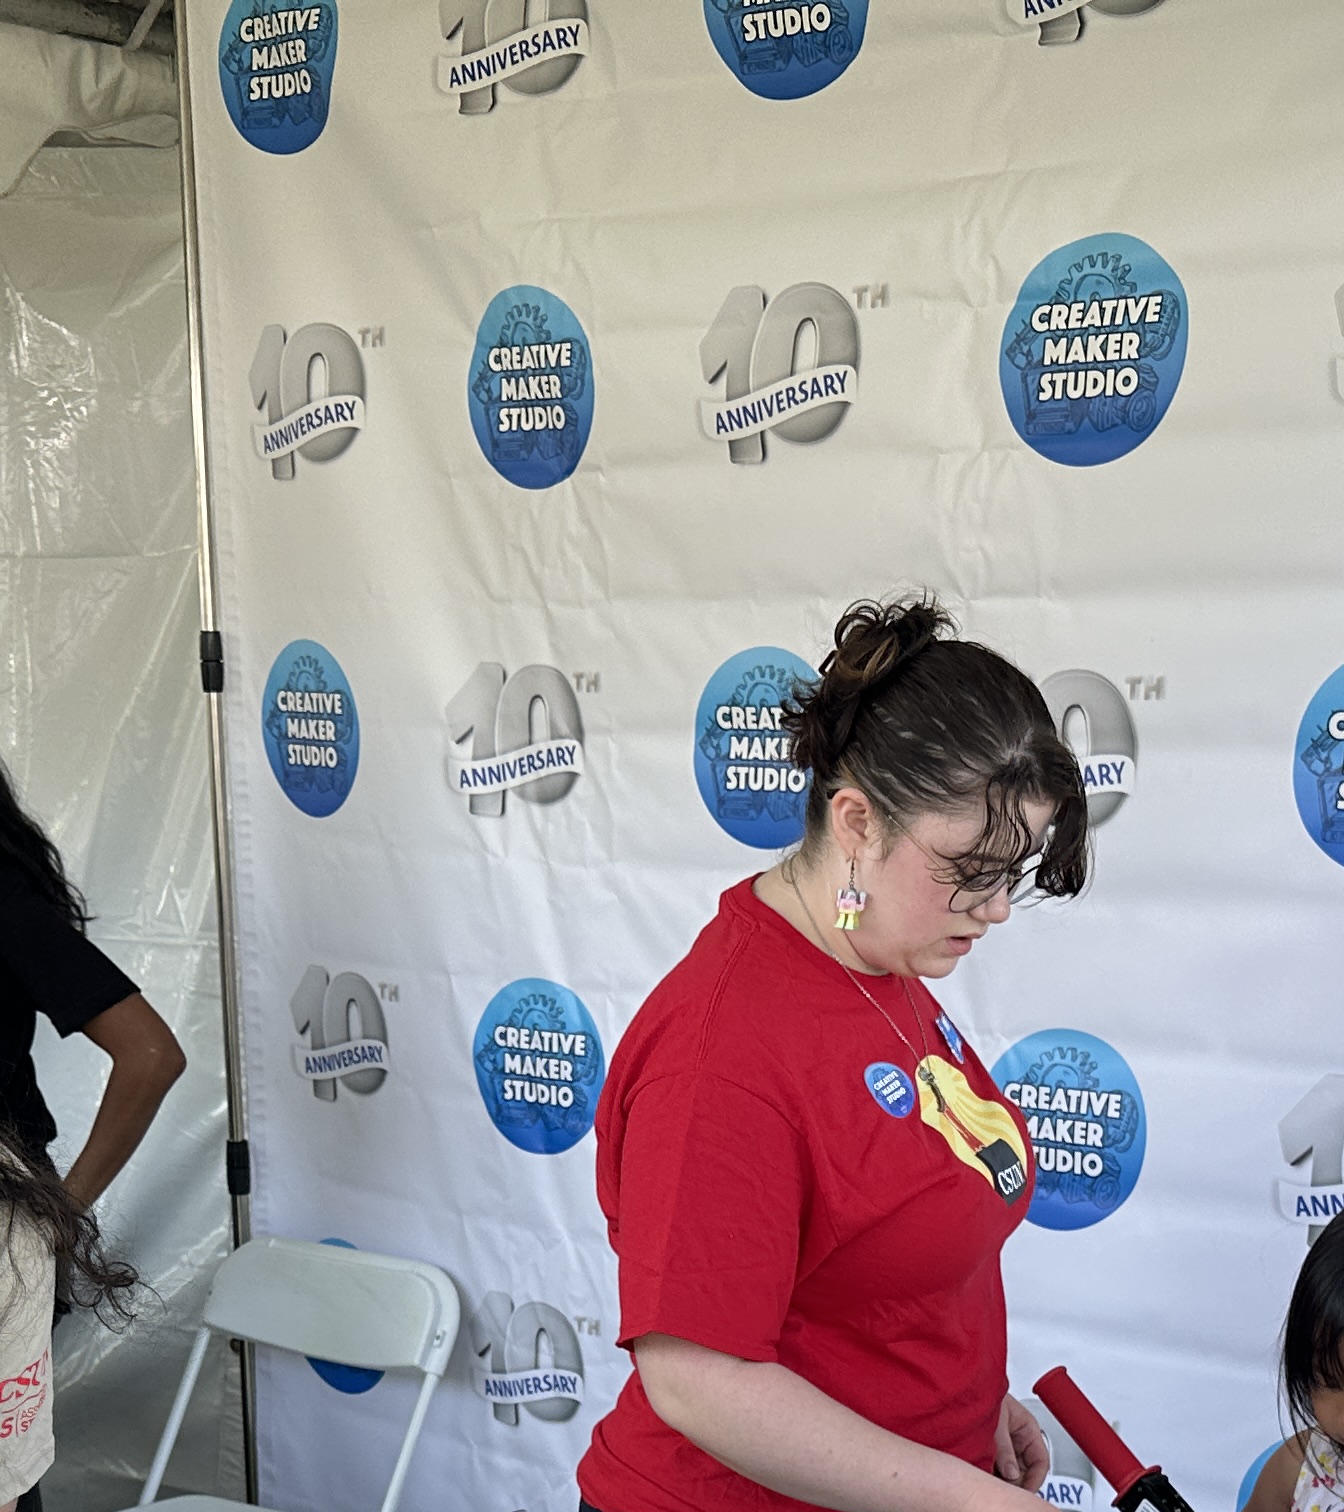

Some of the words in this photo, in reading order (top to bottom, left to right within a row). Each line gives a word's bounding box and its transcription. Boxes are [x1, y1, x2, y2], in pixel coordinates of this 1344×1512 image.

[239, 8, 320, 44] CREATIVE
[742, 3, 831, 42] STUDIO
[252, 38, 307, 72] MAKER
[449, 24, 581, 88] ANNIVERSARY
[250, 70, 312, 101] STUDIO
[1030, 295, 1163, 332] CREATIVE
[489, 343, 571, 372] CREATIVE
[1043, 335, 1140, 365] MAKER
[501, 376, 561, 401] MAKER
[1038, 367, 1138, 401] STUDIO
[714, 370, 849, 435] ANNIVERSARY
[263, 400, 356, 455] ANNIVERSARY
[498, 406, 566, 433] STUDIO
[276, 690, 342, 717] CREATIVE
[716, 706, 784, 730] CREAT
[286, 717, 335, 742] MAKER
[288, 743, 338, 769] STUDIO
[729, 736, 790, 761] MAKE
[458, 746, 577, 790] ANNIVERSARY
[726, 766, 805, 793] STUDIO
[493, 1025, 586, 1058] CREATIVE
[304, 1043, 385, 1076] ANNIVERSARY
[503, 1055, 573, 1082] MAKER
[503, 1079, 574, 1108] STUDIO
[1004, 1083, 1122, 1118] CREATIVE
[485, 1374, 578, 1399] ANNIVERSARY
